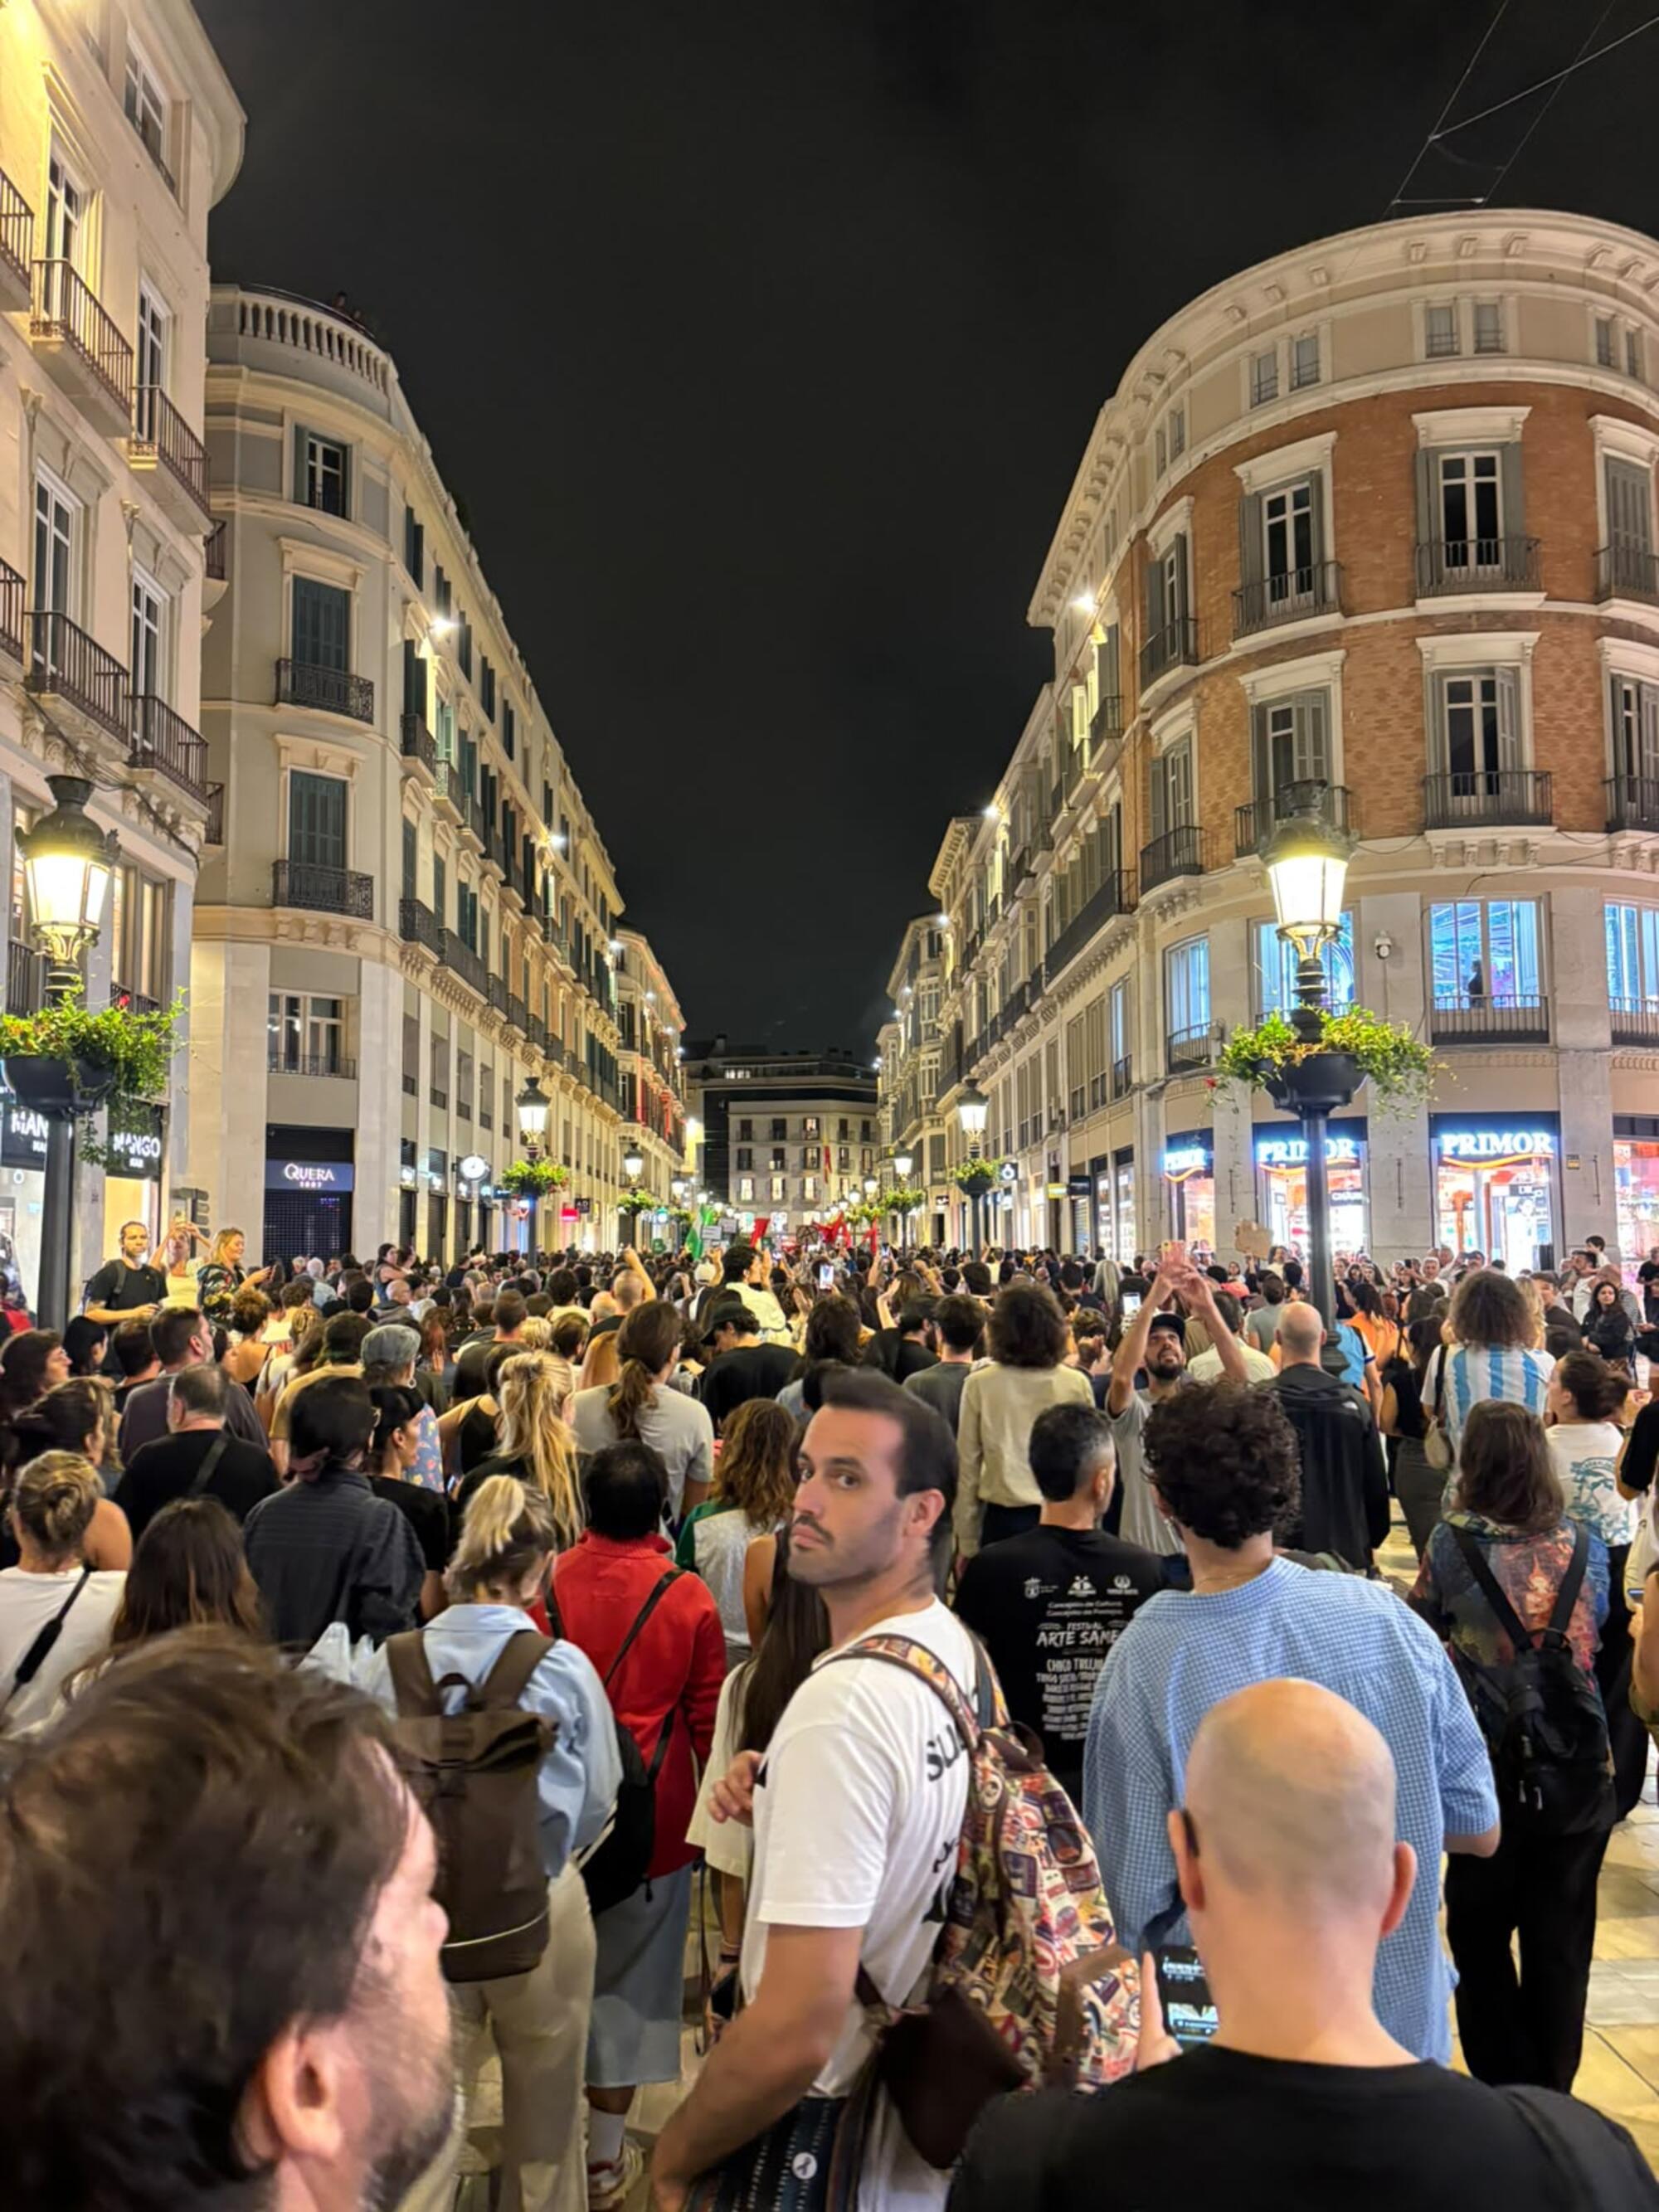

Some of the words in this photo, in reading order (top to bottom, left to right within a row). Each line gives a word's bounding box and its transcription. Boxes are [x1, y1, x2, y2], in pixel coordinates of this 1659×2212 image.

[113, 1132, 161, 1158] MANGO
[1443, 1133, 1554, 1155] PRIMOR
[284, 1163, 335, 1181] QUERA
[1067, 1621, 1104, 1631] FESTIVAL
[1035, 1631, 1076, 1647] ARTE
